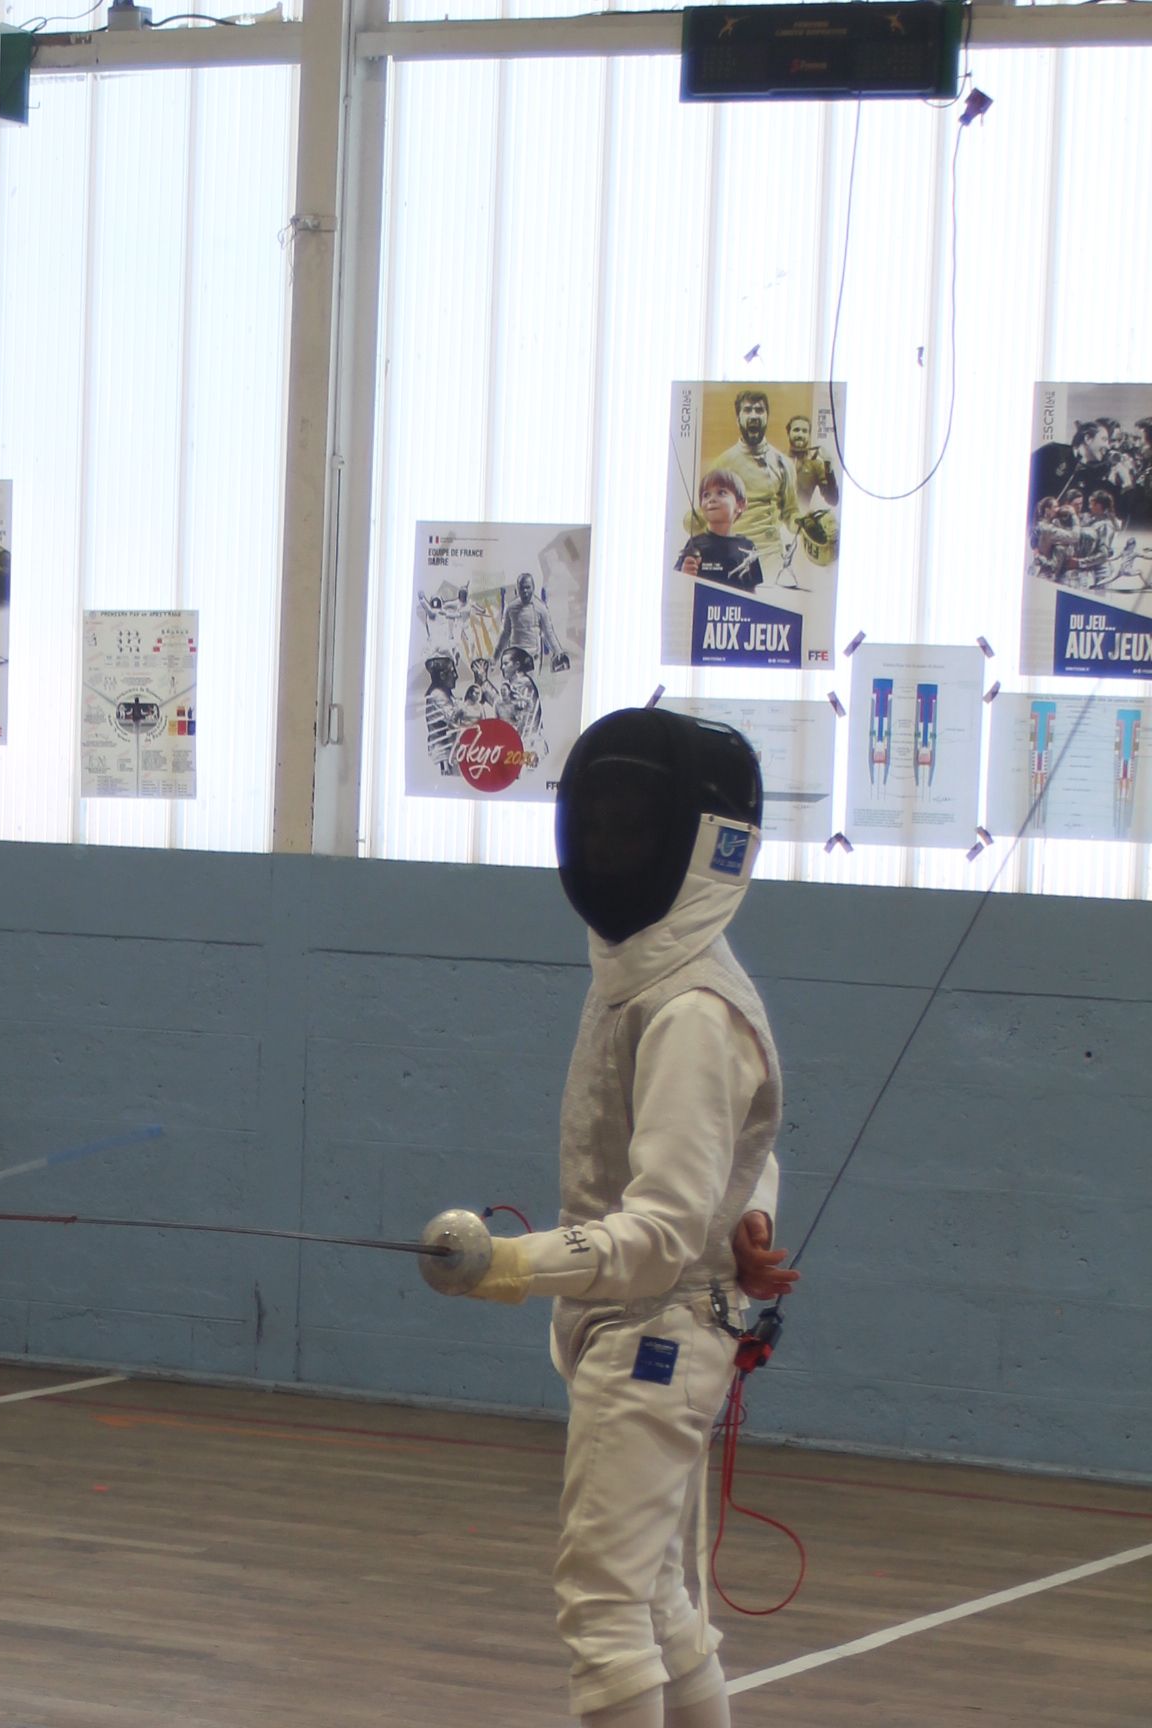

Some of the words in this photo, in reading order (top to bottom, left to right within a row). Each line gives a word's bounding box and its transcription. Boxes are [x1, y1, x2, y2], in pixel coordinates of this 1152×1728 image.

[707, 606, 721, 621] DU
[1069, 614, 1084, 630] DU
[702, 622, 740, 650] AUX
[744, 624, 791, 652] JEUX
[1064, 631, 1105, 660] AUX
[808, 651, 829, 661] FFE
[448, 724, 506, 780] Tokyo
[546, 781, 559, 790] FF
